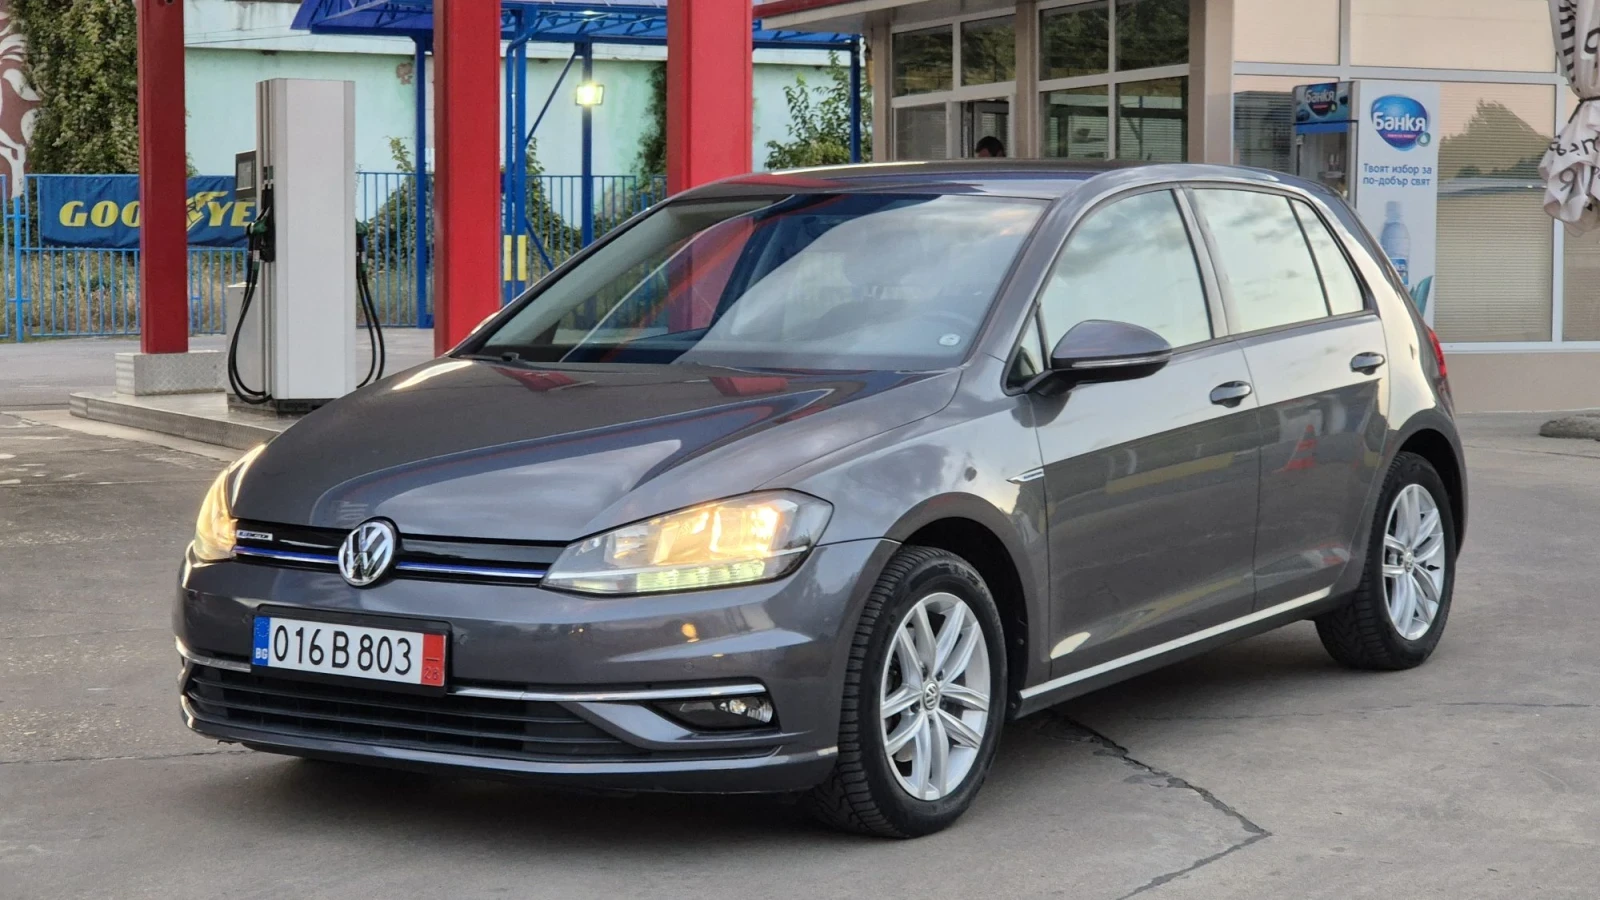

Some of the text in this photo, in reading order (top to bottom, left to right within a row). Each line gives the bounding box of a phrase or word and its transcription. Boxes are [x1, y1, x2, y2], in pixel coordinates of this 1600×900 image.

[1372, 111, 1426, 131] Банкя
[1363, 163, 1432, 176] Твоят избор за
[1362, 175, 1430, 187] по-добър свят
[58, 199, 256, 228] GOOYE
[255, 647, 268, 660] BG
